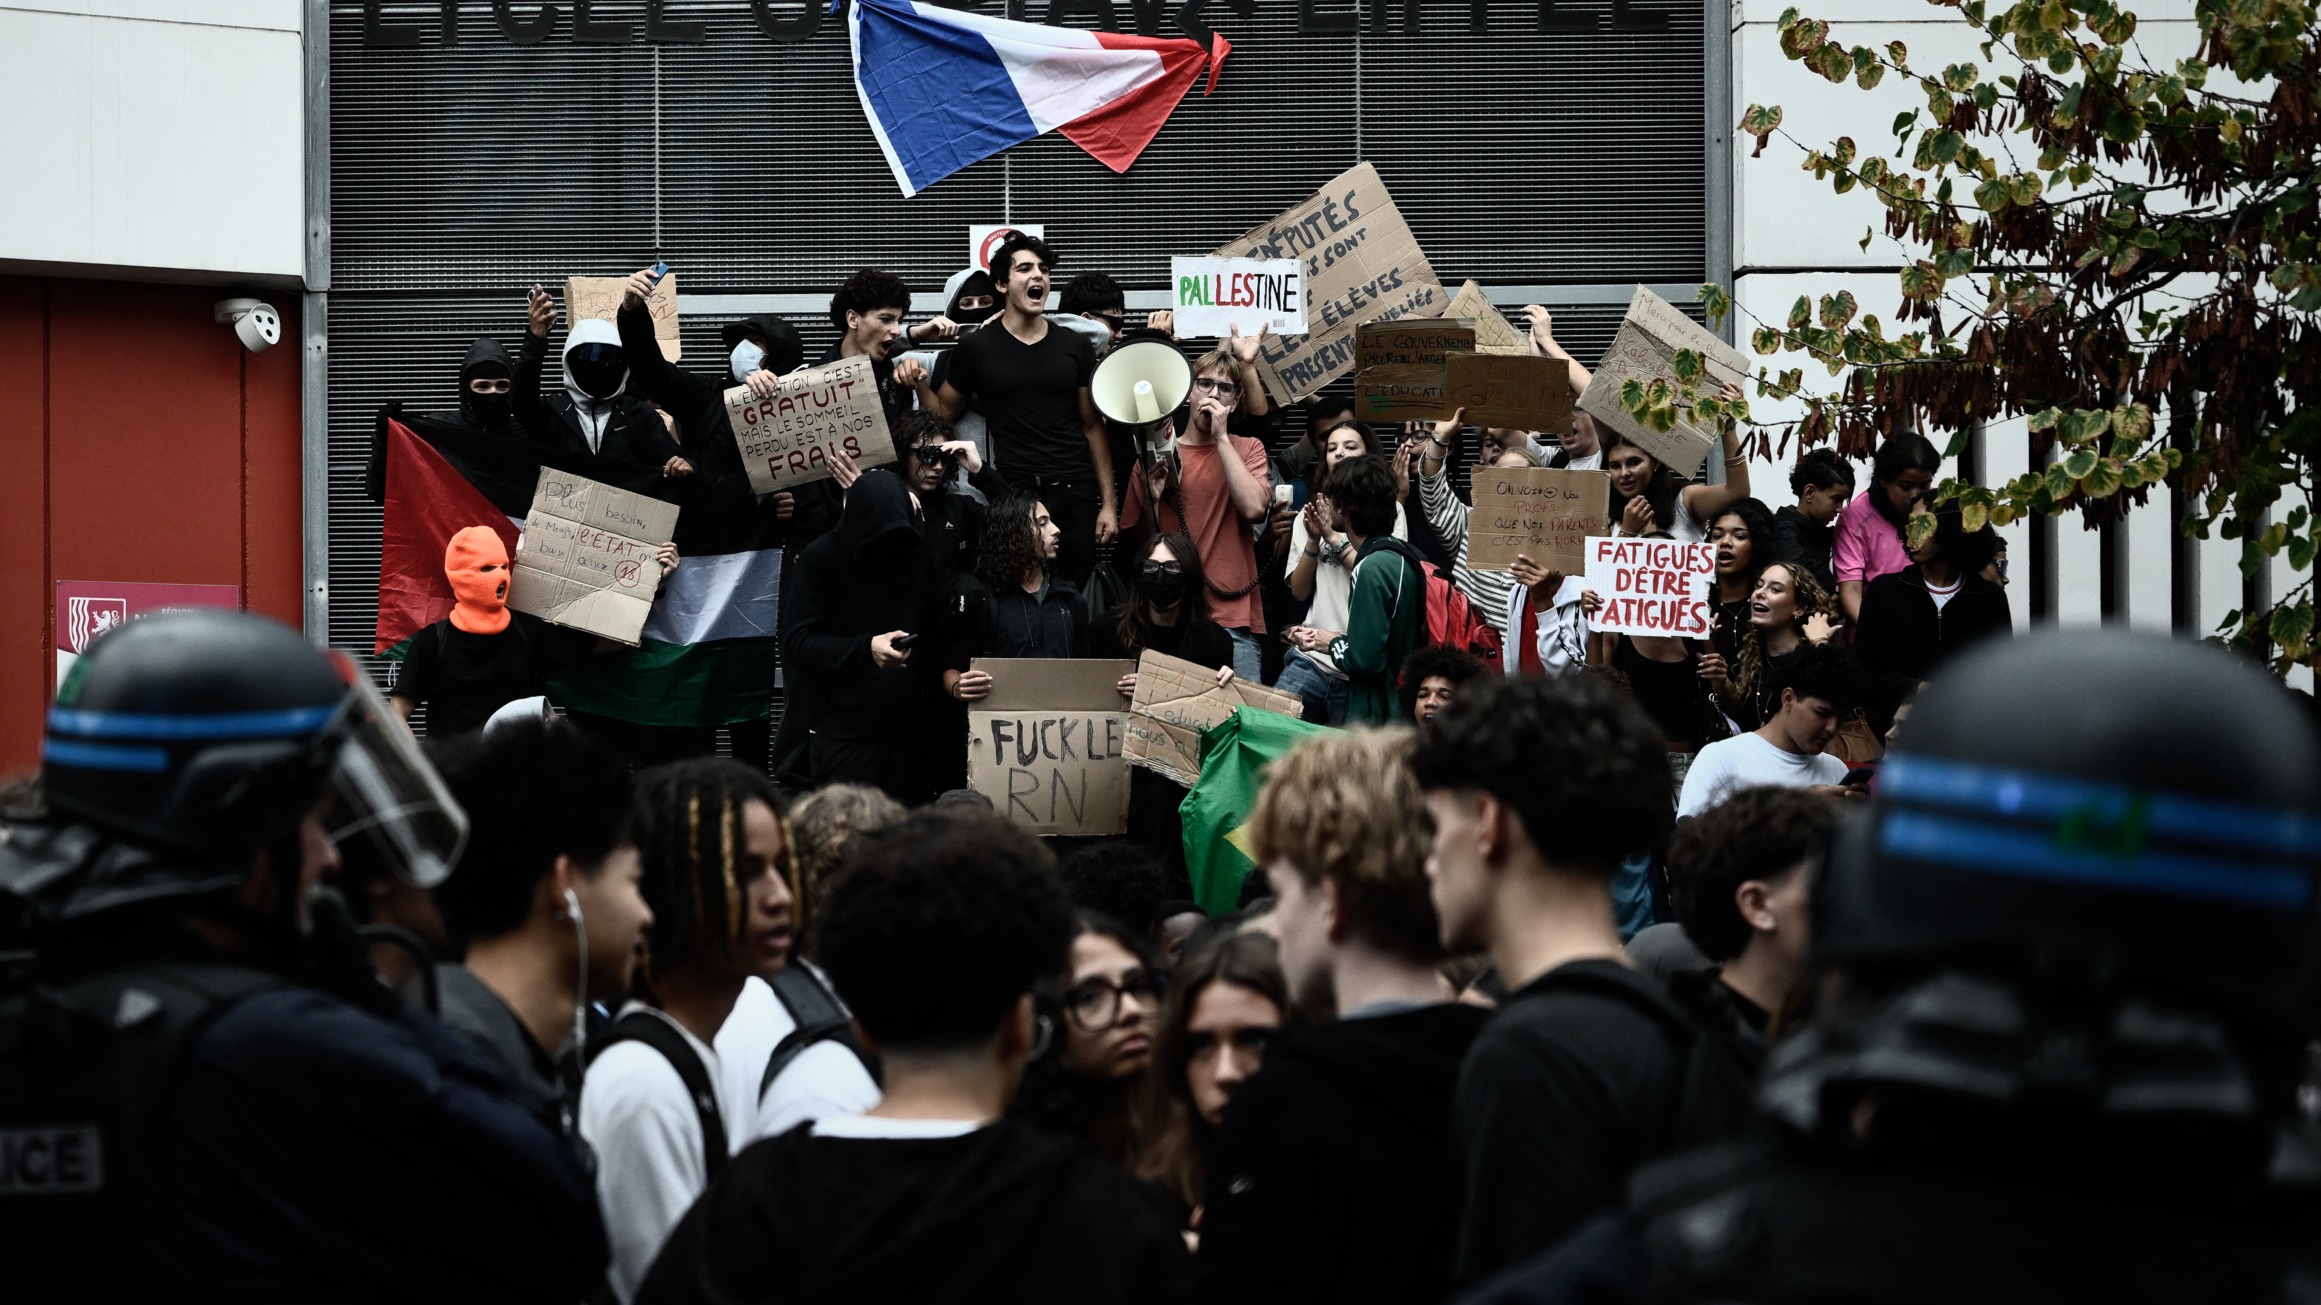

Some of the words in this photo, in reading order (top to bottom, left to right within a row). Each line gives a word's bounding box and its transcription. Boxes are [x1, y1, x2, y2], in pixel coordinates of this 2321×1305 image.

[1324, 227, 1367, 269] SONT
[1180, 272, 1299, 313] PALLESTINE
[1320, 267, 1404, 328] ÉLÈVES
[1362, 335, 1385, 349] LE
[823, 363, 863, 384] C'EST
[1364, 385, 1443, 398] L'EDUCATI
[740, 425, 773, 444] MAIS
[776, 419, 793, 434] LE
[745, 439, 789, 458] PERDU
[795, 427, 823, 447] EST
[828, 422, 838, 438] À
[842, 415, 873, 434] NOS
[1496, 481, 1514, 496] ON
[1494, 518, 1517, 530] QUE
[1550, 516, 1597, 531] PARENTS
[1597, 541, 1714, 574] FATIGUÉS
[1615, 565, 1691, 596] D'ÊTRE
[991, 715, 1079, 767] FUCK
[1086, 715, 1124, 761] LE
[1007, 767, 1088, 829] RN
[0, 1133, 88, 1185] ICE
